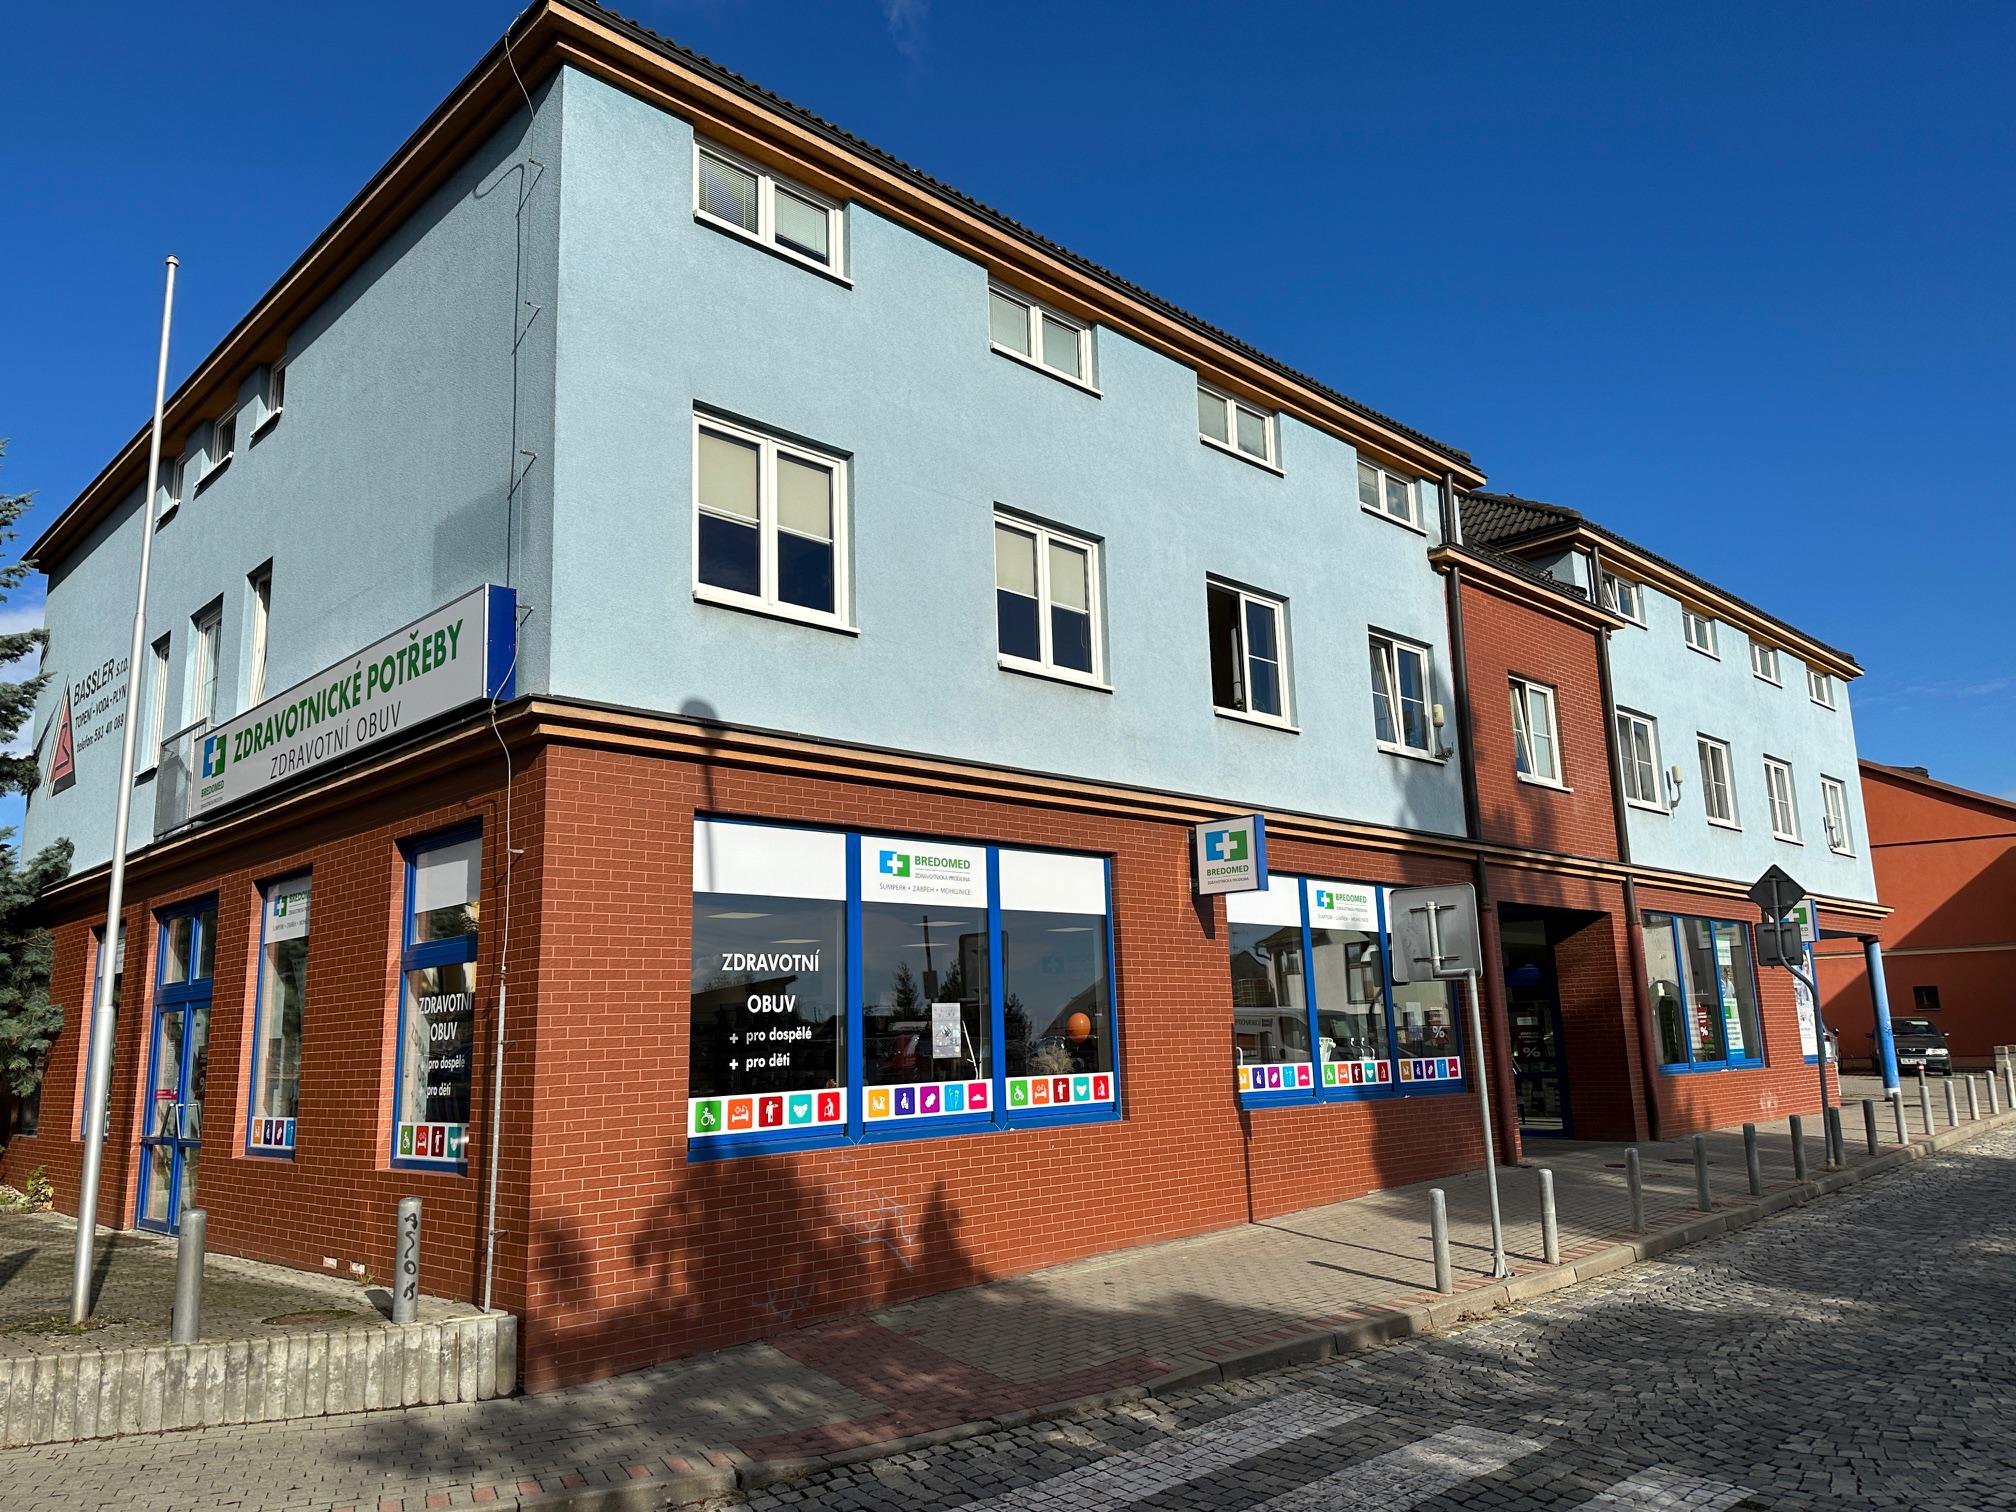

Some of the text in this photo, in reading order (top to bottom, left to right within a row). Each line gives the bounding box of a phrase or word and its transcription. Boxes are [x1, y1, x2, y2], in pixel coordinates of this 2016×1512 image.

[74, 658, 115, 706] BASSLER
[233, 619, 463, 763] ZDRAVOTNICKÉ POTŘEBY
[112, 684, 127, 706] PLYN
[270, 701, 401, 779] ZDRAVOTNÍ OBUV
[914, 855, 971, 869] BREDOMED
[1207, 865, 1249, 876] BREDOMED
[879, 882, 906, 891] ŠUMPERK
[1335, 893, 1368, 904] BREDOMED
[722, 949, 820, 972] ZDRAVOTNÍ
[747, 994, 796, 1013] OBUV
[430, 1021, 458, 1041] OBUV
[746, 1026, 812, 1045] pro dospělé
[428, 1059, 439, 1073] pro
[746, 1052, 790, 1071] pro děti
[426, 1082, 451, 1098] pro děti
